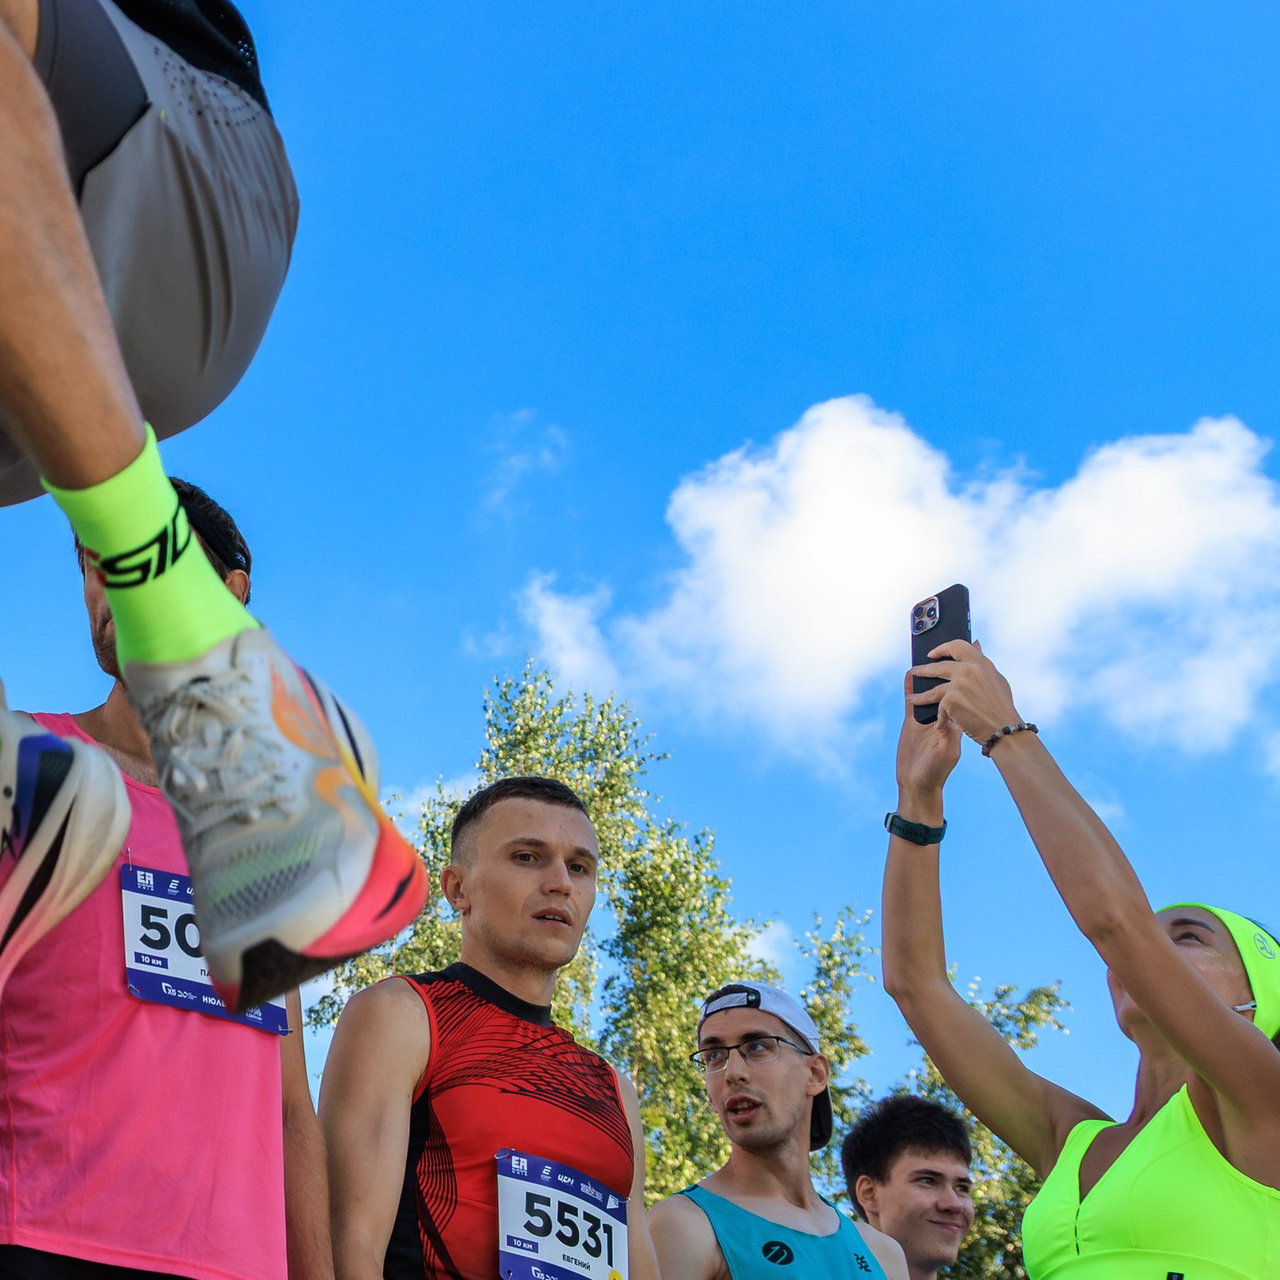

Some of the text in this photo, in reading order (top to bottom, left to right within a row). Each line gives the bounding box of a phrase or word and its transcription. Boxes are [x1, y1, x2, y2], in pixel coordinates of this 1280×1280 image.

[139, 904, 206, 958] 50
[141, 955, 150, 964] 10
[523, 1191, 614, 1268] 5531
[513, 1238, 522, 1247] 10
[562, 1253, 591, 1271] ЕВГЕНИЙ
